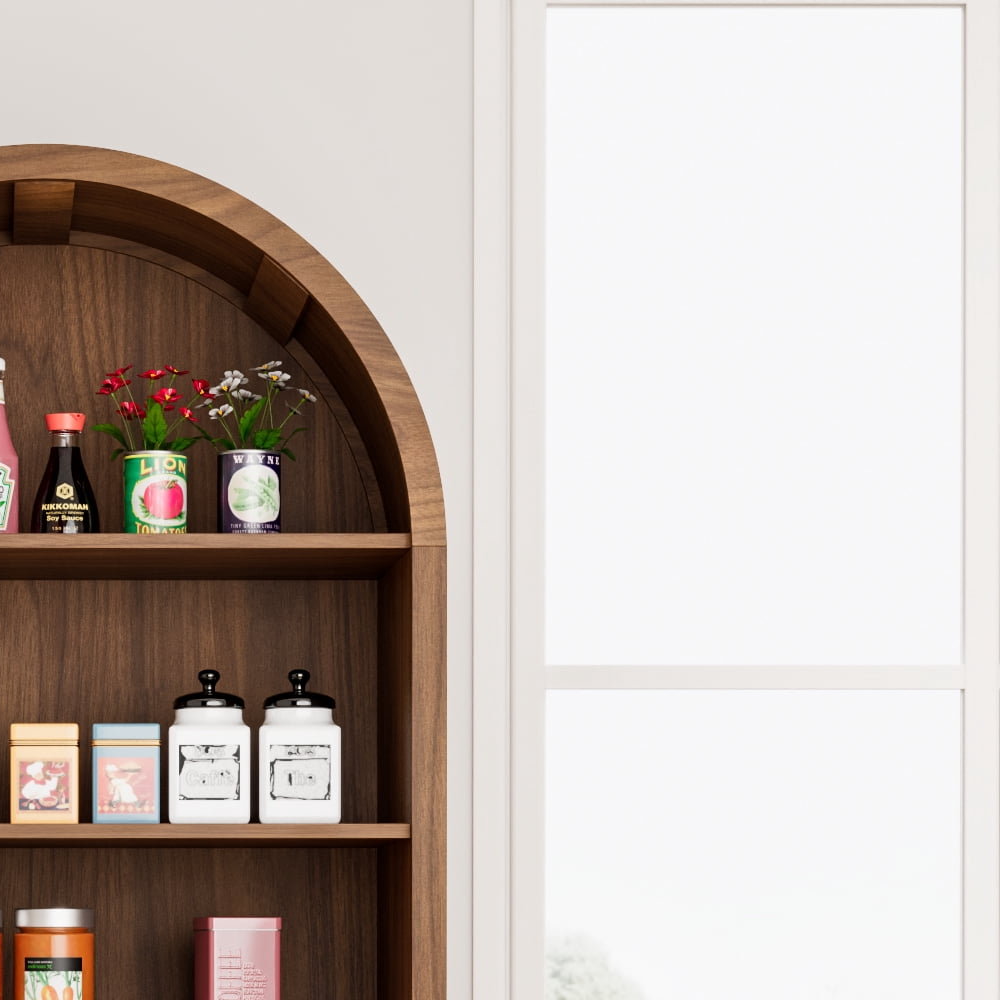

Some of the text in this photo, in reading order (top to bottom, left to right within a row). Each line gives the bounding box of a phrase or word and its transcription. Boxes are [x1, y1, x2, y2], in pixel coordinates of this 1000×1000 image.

[232, 453, 280, 466] WAYNE
[140, 457, 186, 476] LION
[41, 502, 89, 511] KIKKOMAN
